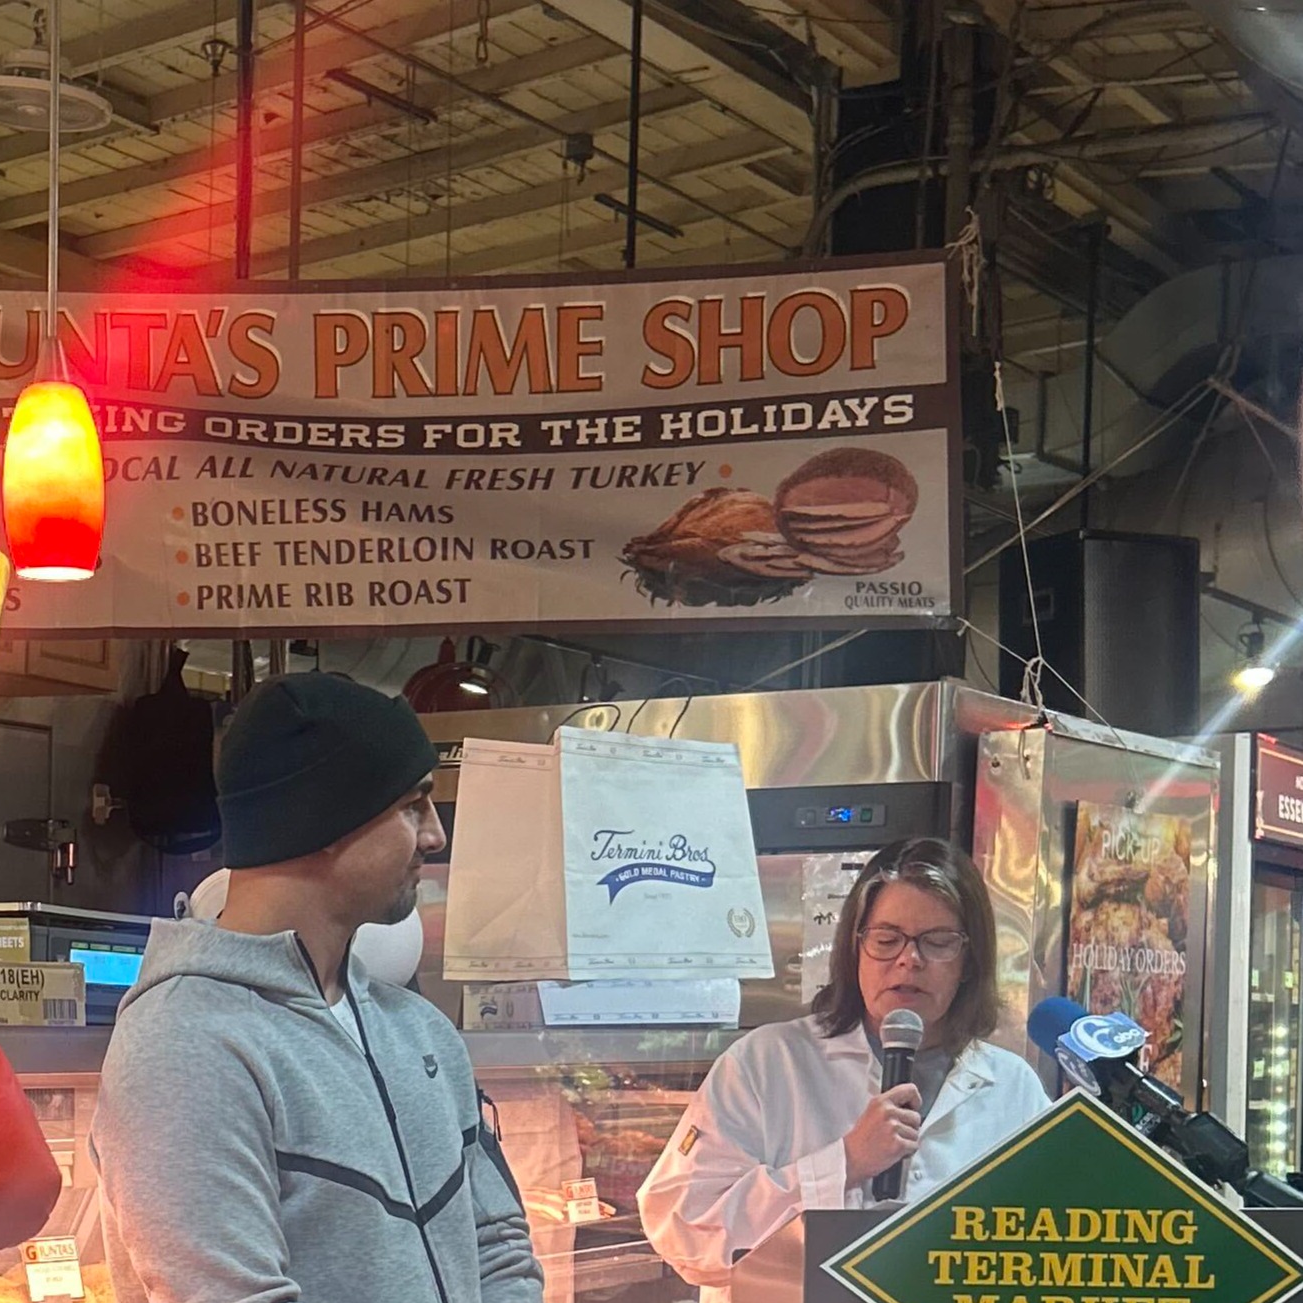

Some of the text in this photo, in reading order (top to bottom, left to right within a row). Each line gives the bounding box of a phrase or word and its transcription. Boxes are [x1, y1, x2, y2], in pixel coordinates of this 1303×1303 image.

[313, 302, 605, 399] PRIME
[642, 283, 911, 391] SHOP
[205, 416, 405, 448] ORDERS
[423, 422, 522, 448] FOR
[541, 415, 641, 446] THE
[660, 394, 914, 441] HOLIDAYS
[101, 455, 705, 491] OCAL ALL NATURAL FRESH TURKEY
[192, 498, 454, 527] BONELESS HAMS
[195, 536, 595, 567] BEEF TENDERLOIN ROAST
[197, 579, 471, 609] PRIME RIB ROAST
[844, 595, 935, 610] QUALITY MEATS
[856, 581, 922, 596] PASSIO
[1279, 794, 1303, 823] ESSE
[590, 830, 664, 861] Termini
[618, 867, 700, 883] GOLD MEDAL PASTRY
[1073, 943, 1186, 974] HOLIDAY ORDERS
[0, 989, 41, 1001] CLARITY
[950, 1206, 1198, 1245] READING
[928, 1251, 1215, 1289] TERMINAL
